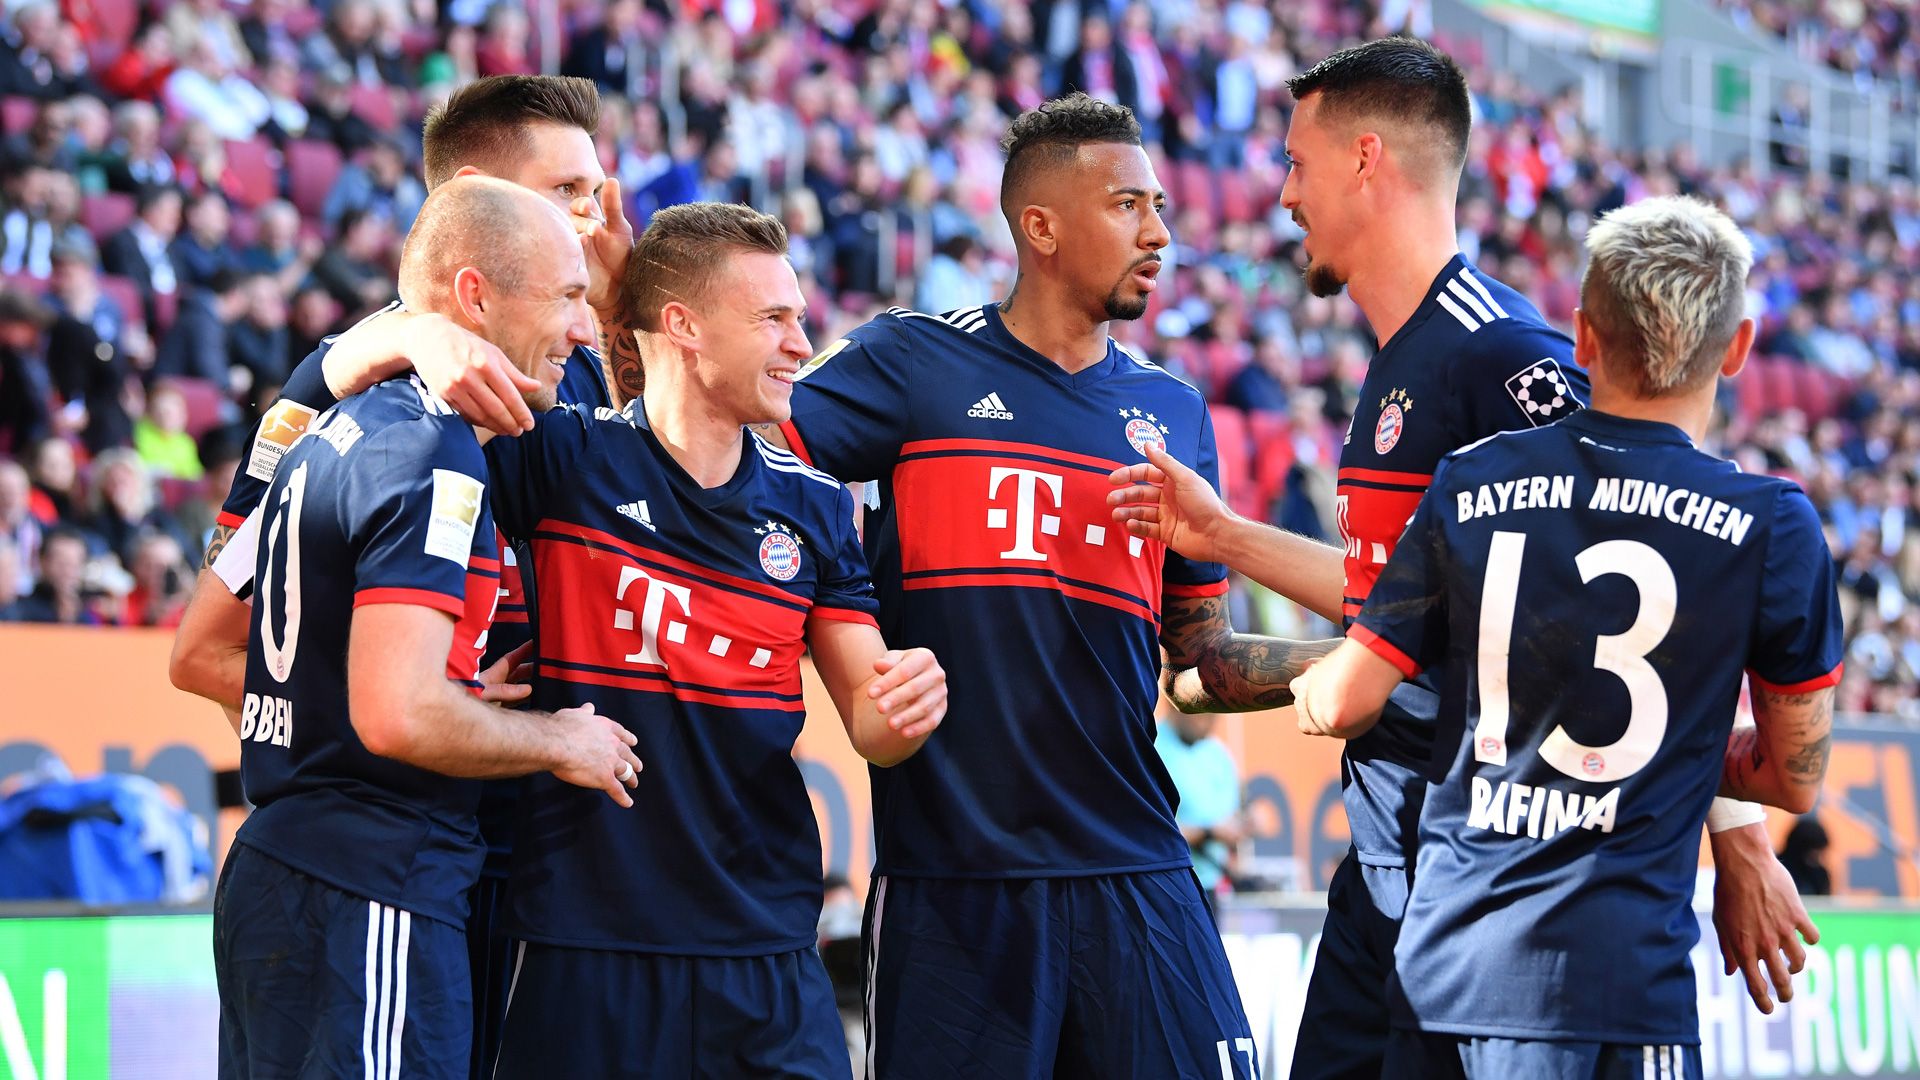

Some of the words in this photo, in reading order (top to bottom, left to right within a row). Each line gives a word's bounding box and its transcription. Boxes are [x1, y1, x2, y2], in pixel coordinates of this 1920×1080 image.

[967, 406, 1014, 420] adidas
[1457, 475, 1574, 523] BAYERN
[1589, 478, 1754, 546] MÜNCHEN
[770, 535, 799, 558] BAYERN
[1475, 531, 1678, 783] 13
